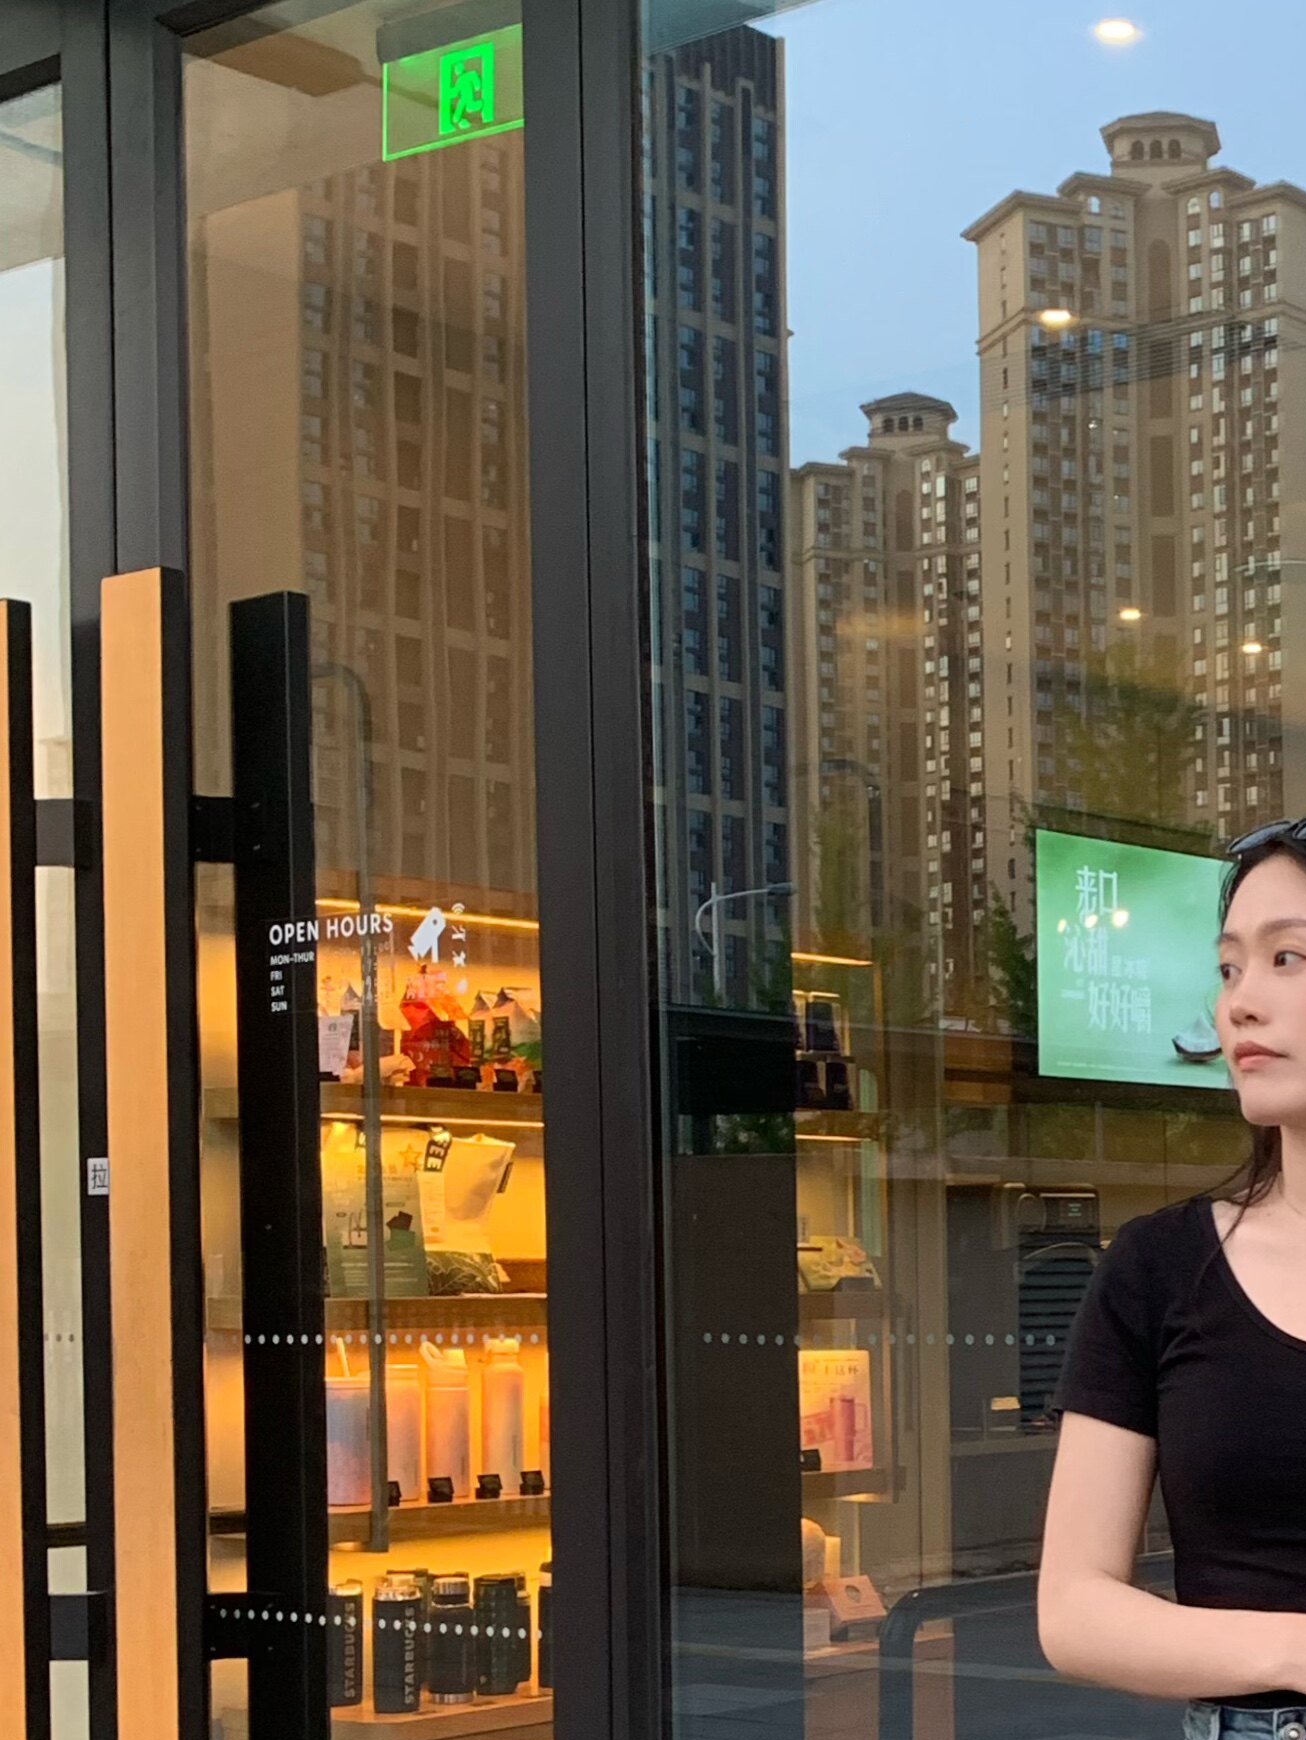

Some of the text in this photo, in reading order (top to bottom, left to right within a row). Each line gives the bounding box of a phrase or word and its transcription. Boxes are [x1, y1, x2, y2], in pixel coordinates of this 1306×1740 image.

[269, 912, 394, 946] OPEN HOURS
[270, 970, 283, 981] FRI
[270, 985, 285, 997] SAT
[271, 1000, 288, 1012] SUN
[91, 1163, 109, 1190] 拉
